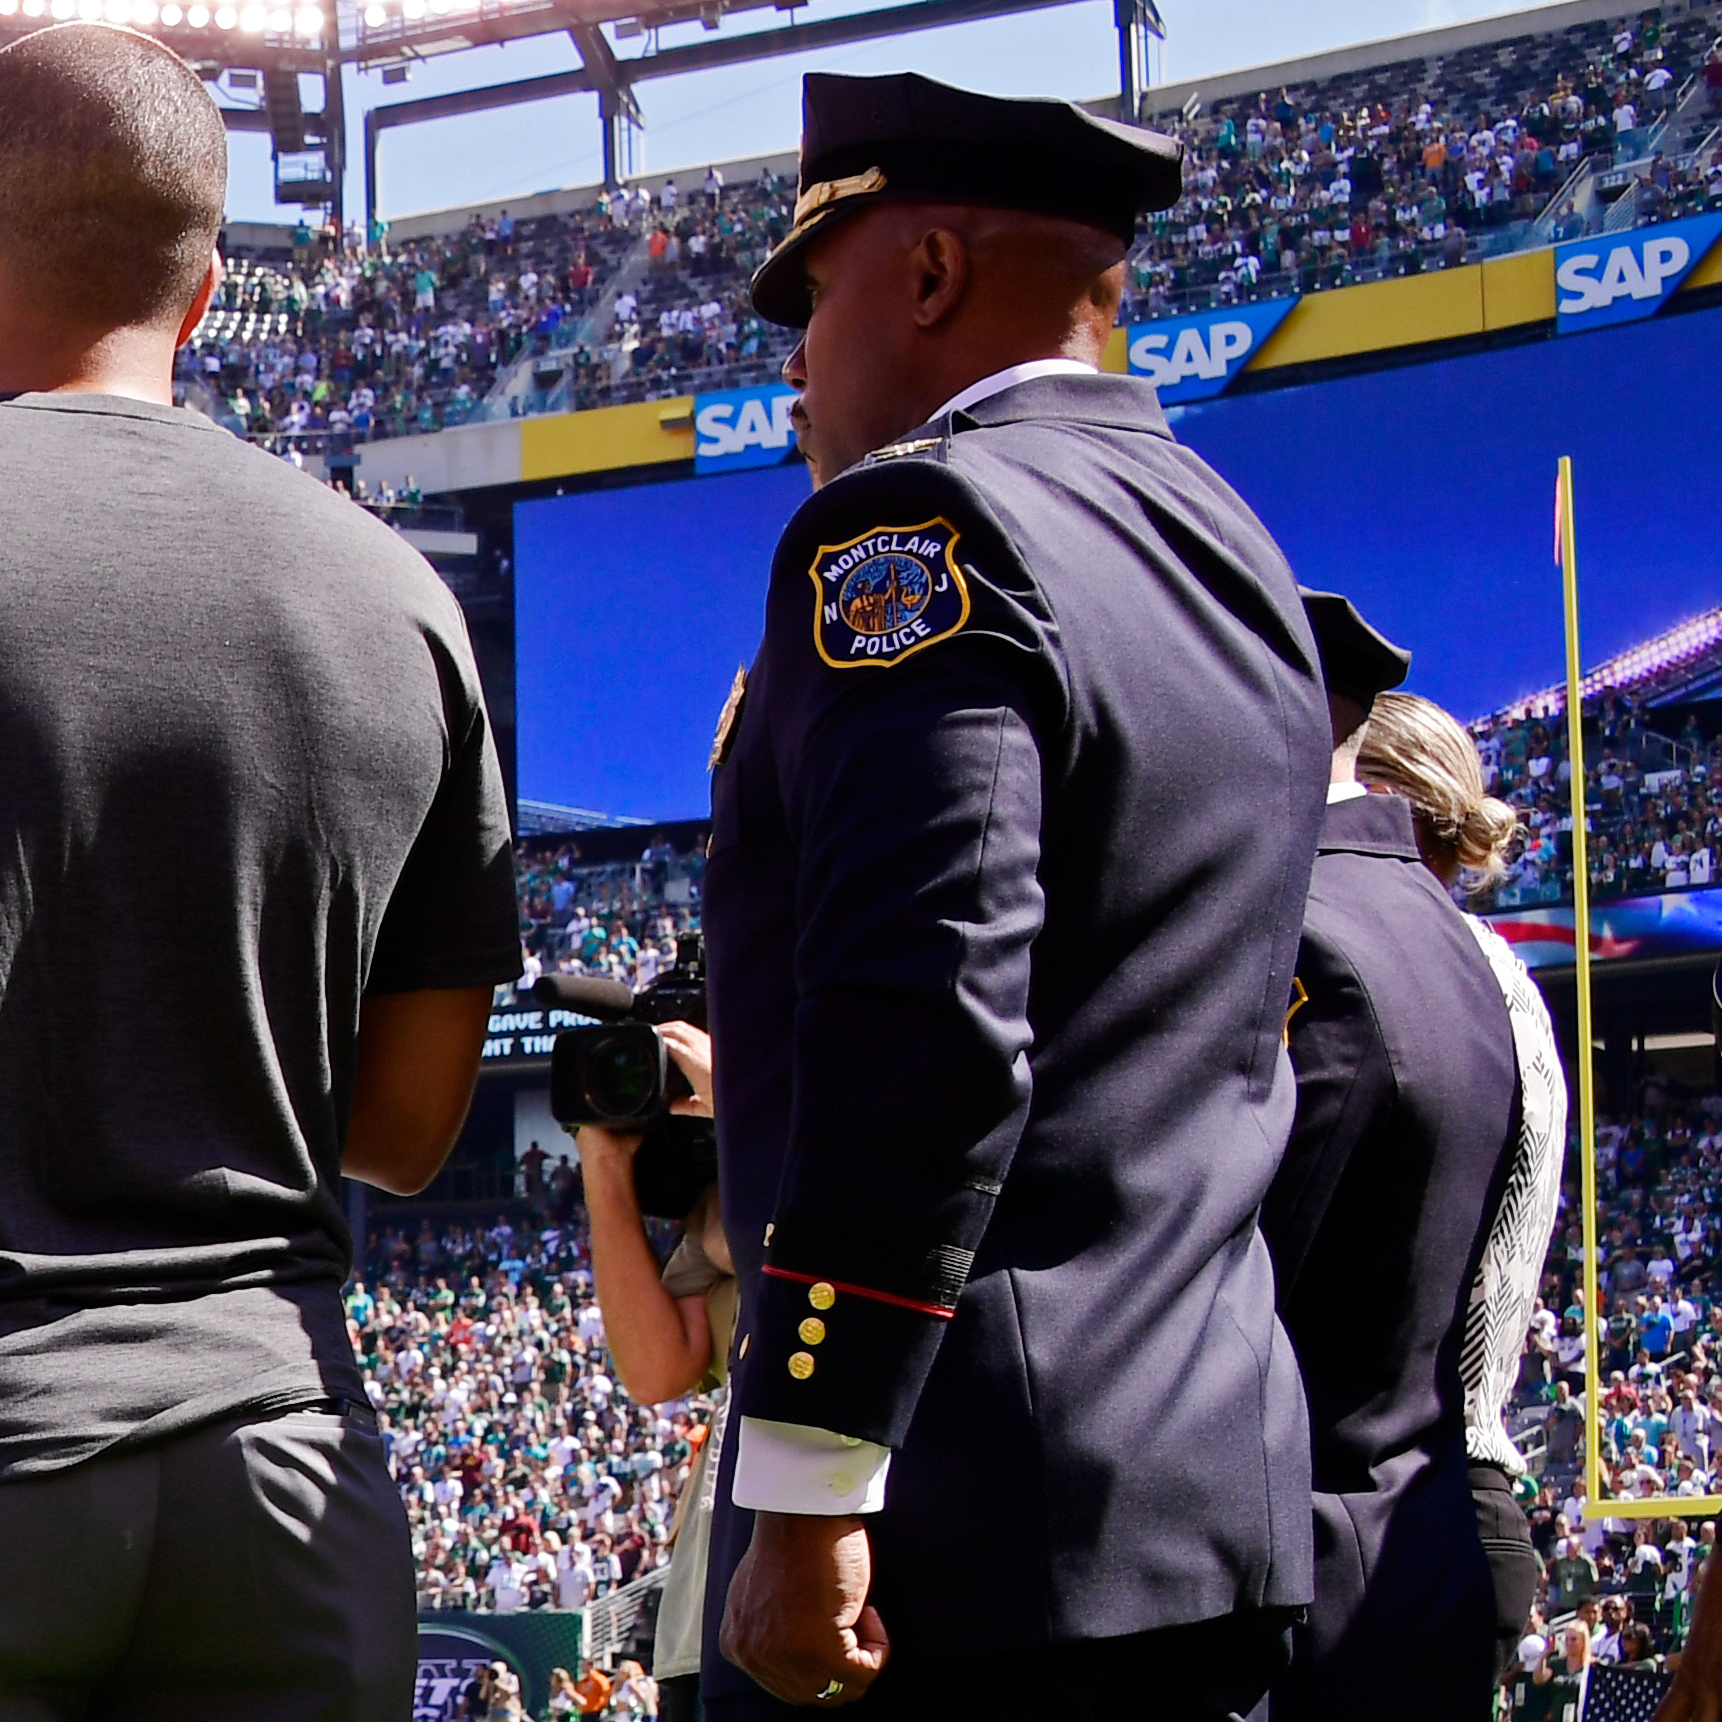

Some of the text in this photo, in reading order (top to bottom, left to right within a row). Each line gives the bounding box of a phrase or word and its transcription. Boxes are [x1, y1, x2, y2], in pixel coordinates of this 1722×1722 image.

[1557, 237, 1690, 314] SAP
[1129, 321, 1252, 387] SAP
[823, 534, 942, 582] MONTCLAIR
[824, 573, 948, 624] N J
[850, 618, 931, 655] POLICE
